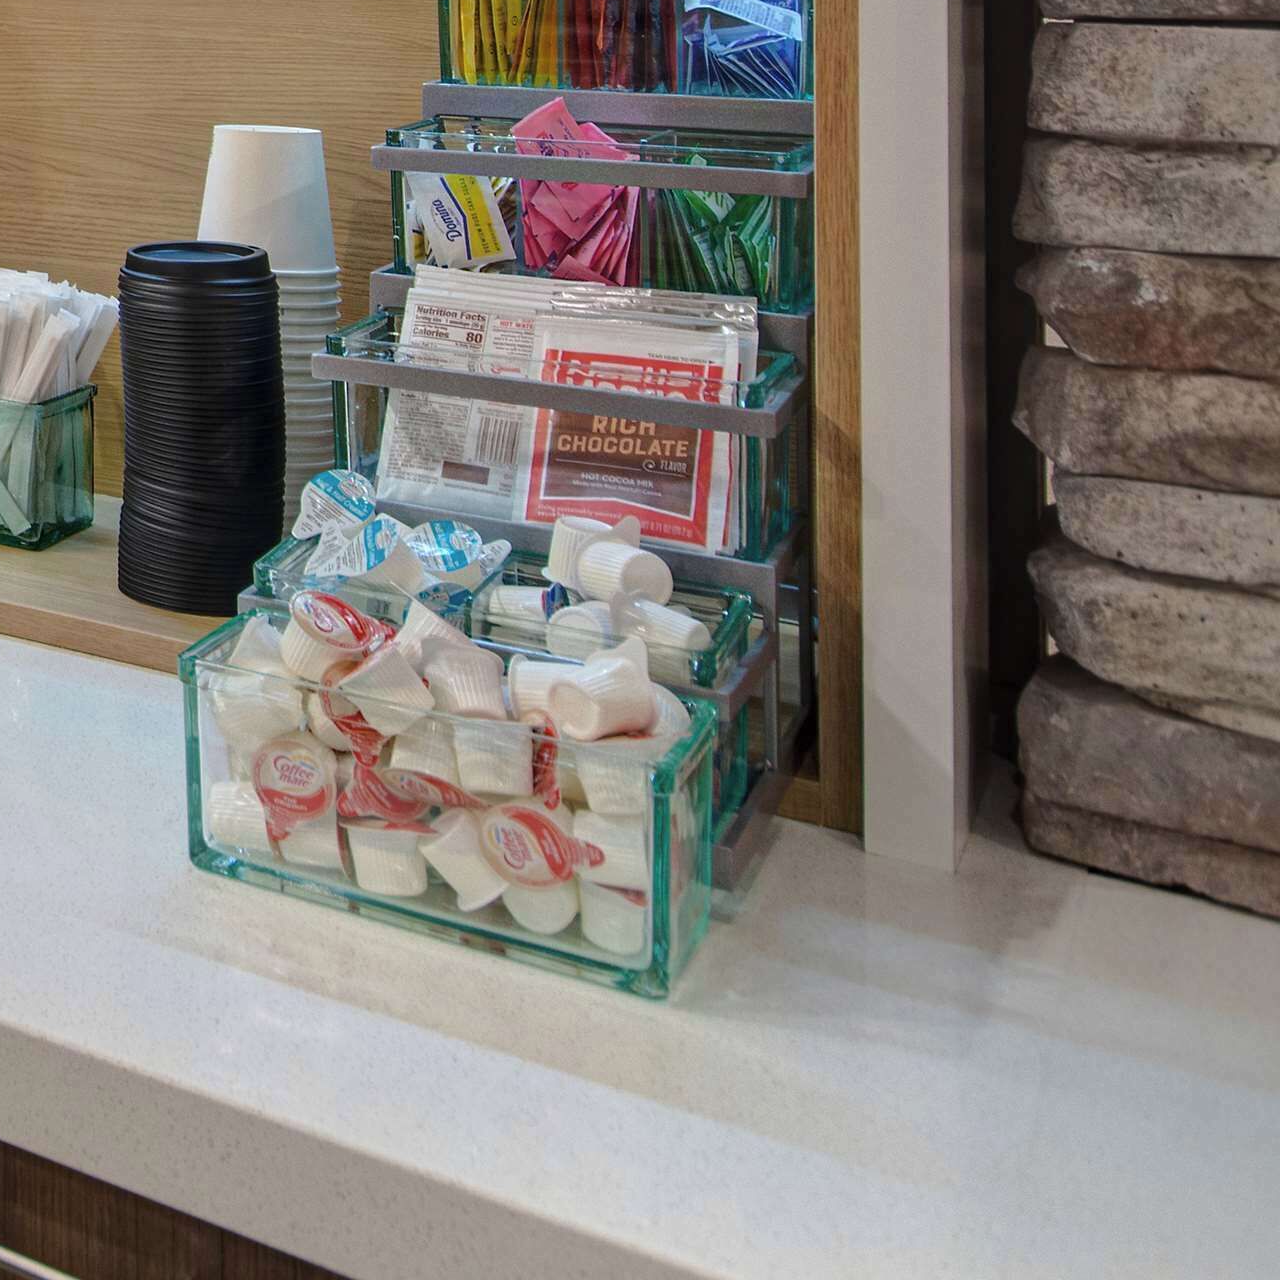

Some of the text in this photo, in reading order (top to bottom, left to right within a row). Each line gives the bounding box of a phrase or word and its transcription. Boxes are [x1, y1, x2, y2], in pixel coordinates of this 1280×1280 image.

[432, 199, 462, 242] Domino
[416, 305, 487, 321] Nutrition Facts
[515, 321, 533, 330] WATE
[413, 327, 449, 339] Calories
[466, 331, 483, 344] 80
[592, 414, 657, 436] RICH
[557, 433, 689, 458] CHOCOLATE
[660, 459, 688, 473] FLAVOR
[581, 472, 655, 489] HOT COCOA MIX
[273, 754, 314, 778] Coffee
[280, 774, 310, 787] mate
